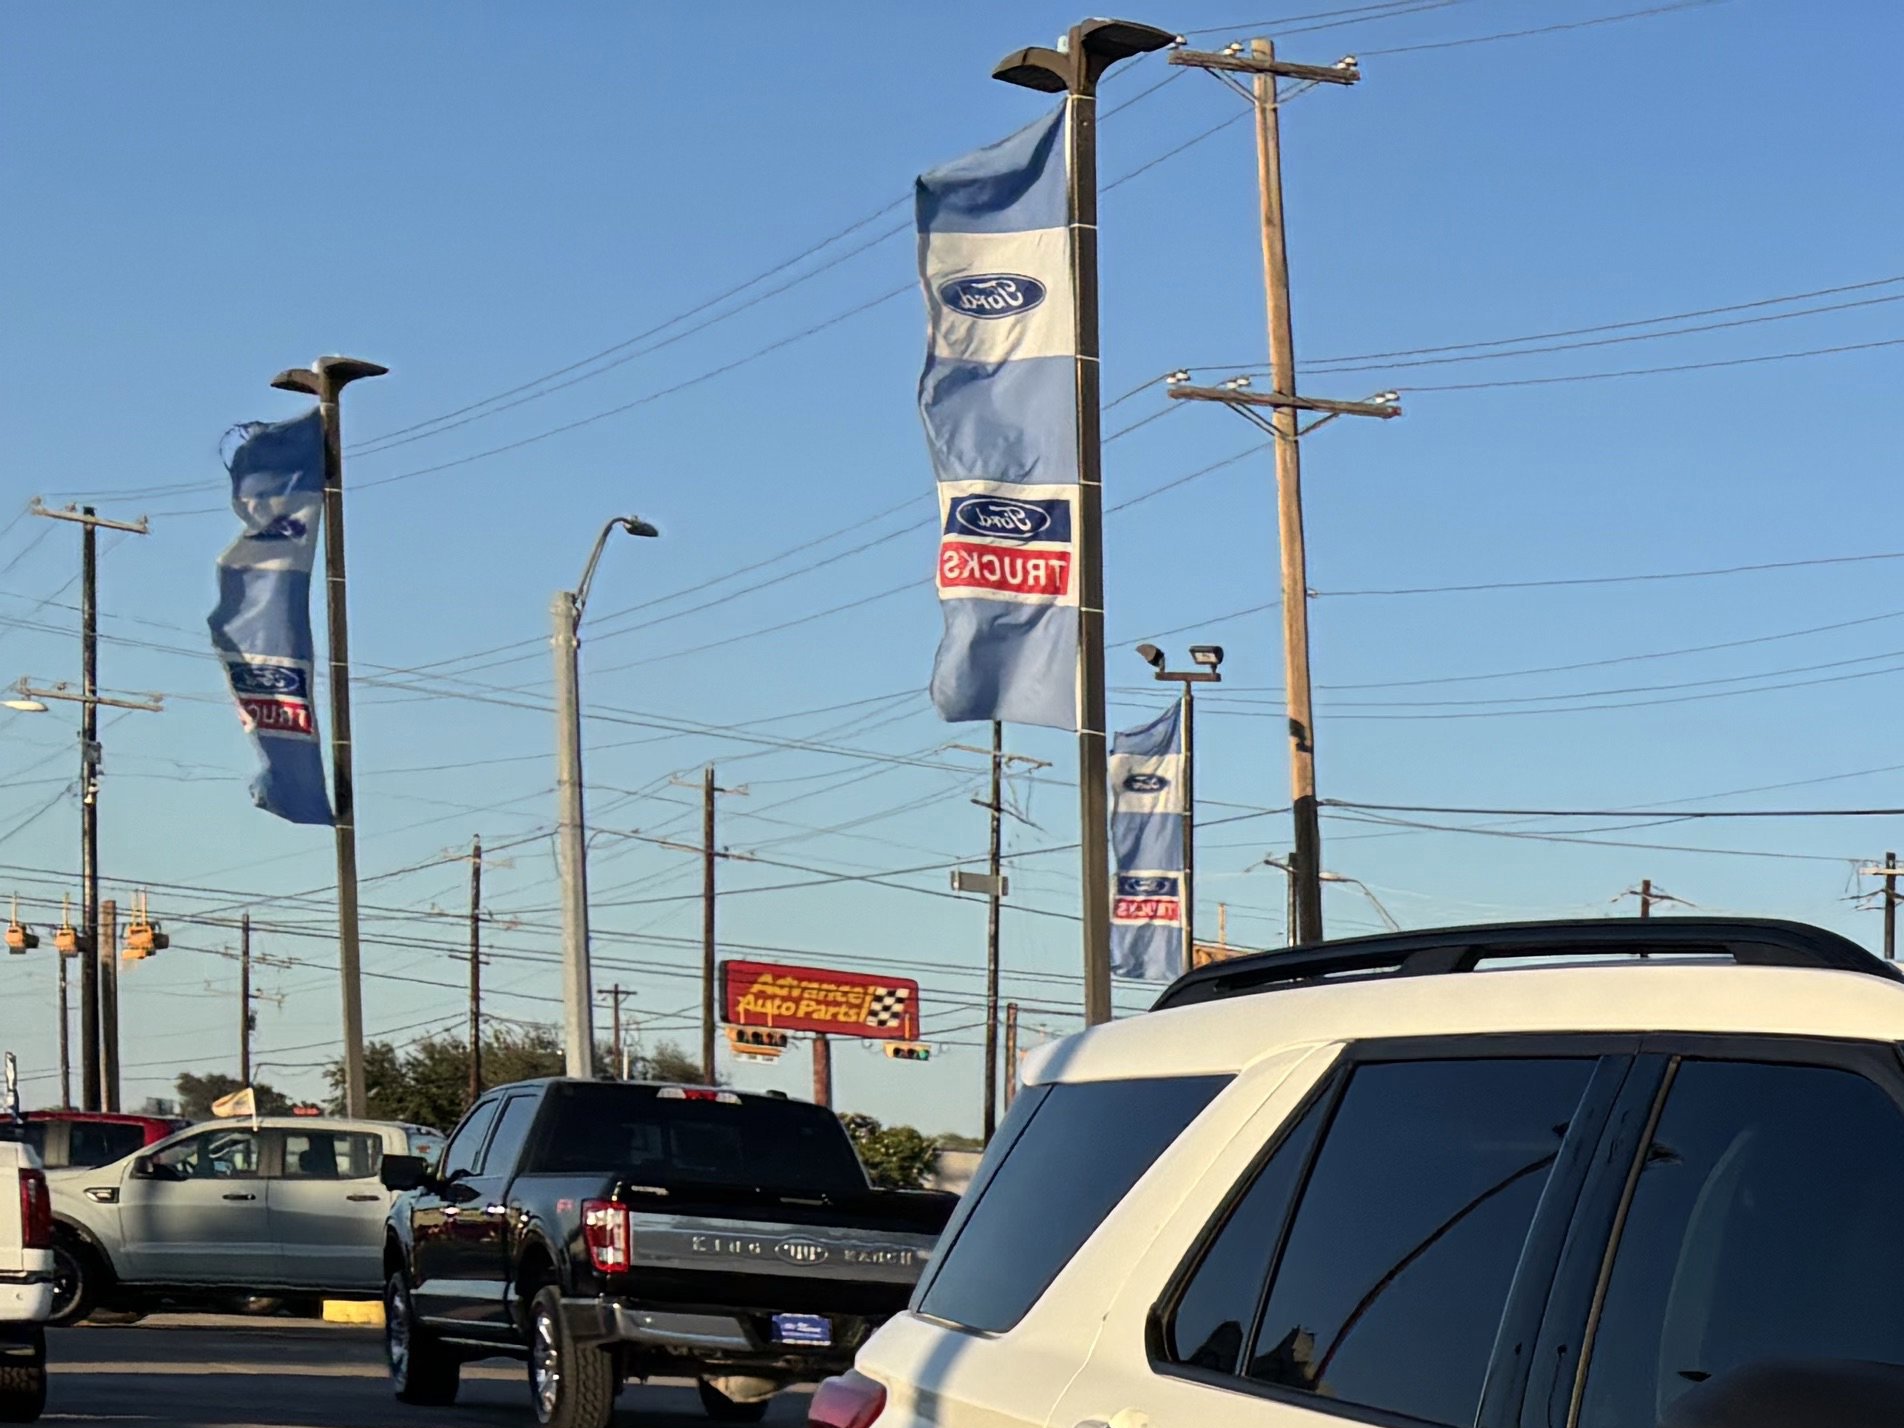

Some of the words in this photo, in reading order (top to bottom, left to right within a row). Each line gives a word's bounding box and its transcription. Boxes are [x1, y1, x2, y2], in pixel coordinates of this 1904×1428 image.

[750, 973, 865, 1005] Advance
[736, 993, 796, 1018] Auto
[796, 998, 861, 1023] Parts
